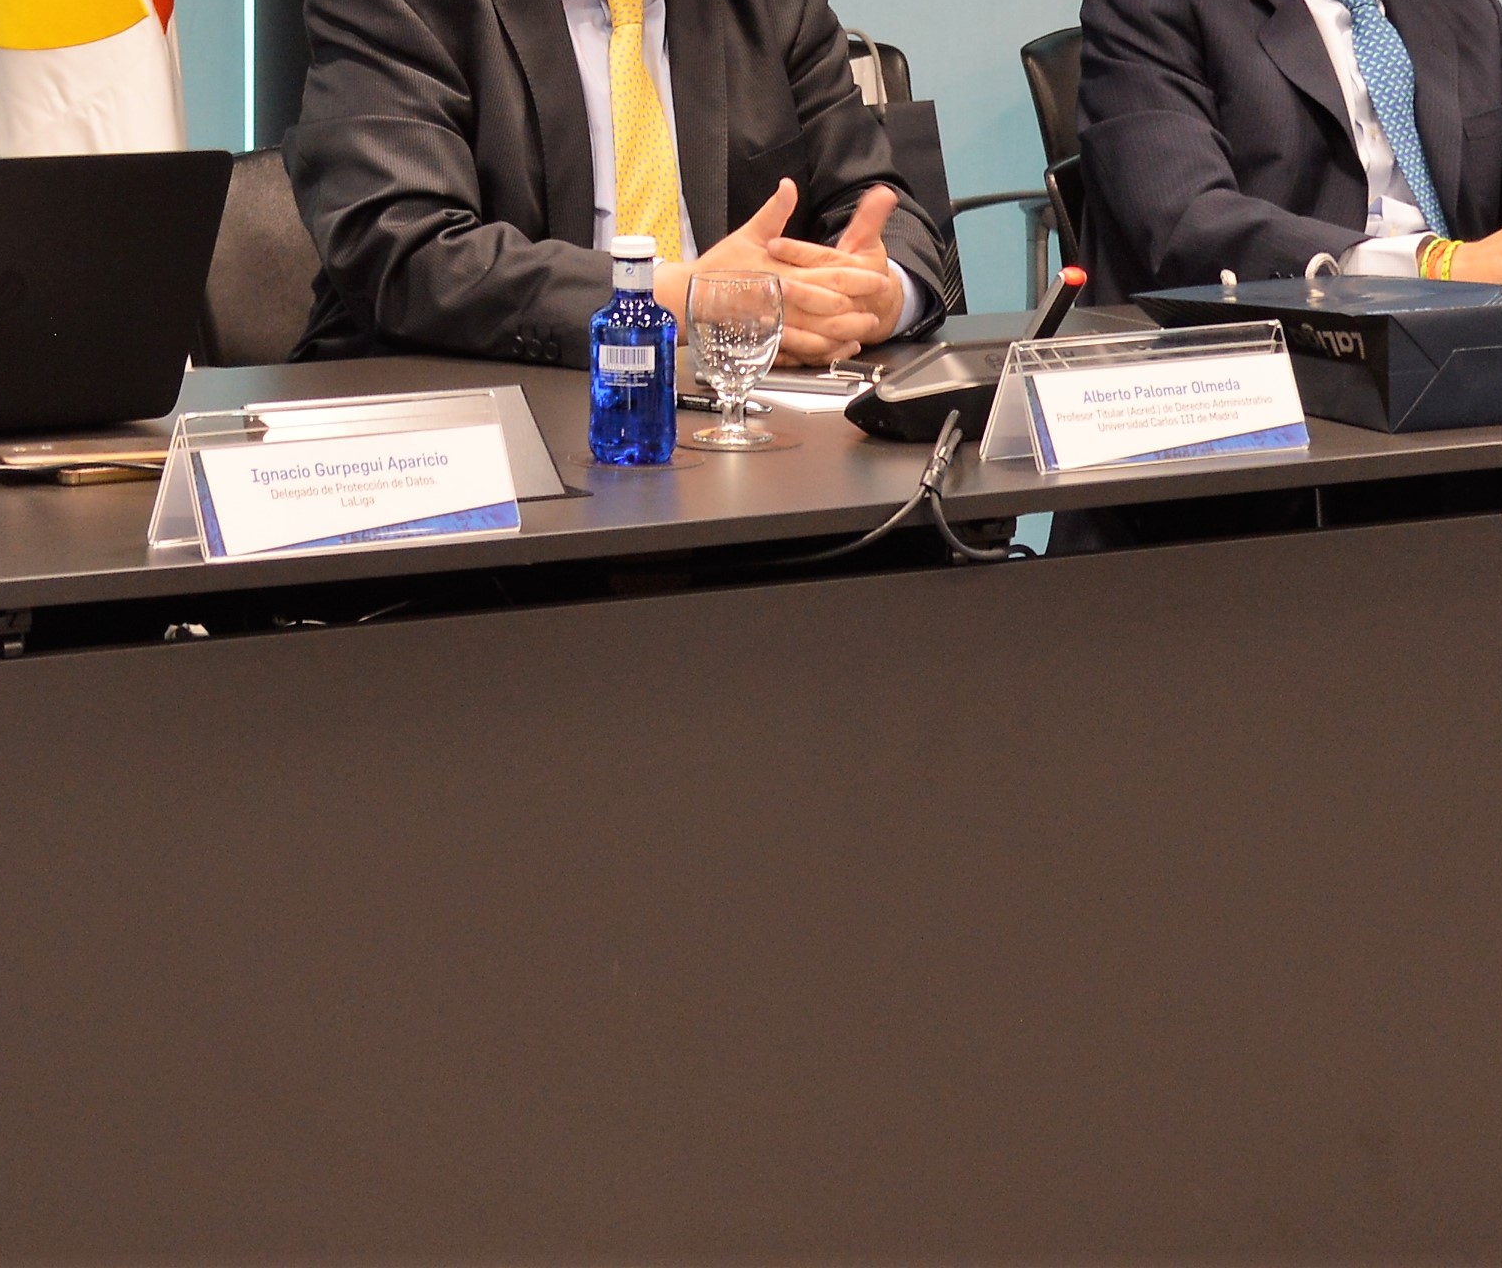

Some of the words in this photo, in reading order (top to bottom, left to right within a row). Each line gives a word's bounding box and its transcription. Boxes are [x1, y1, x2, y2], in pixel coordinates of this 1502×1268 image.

[1083, 388, 1131, 404] Alberto
[1134, 384, 1188, 399] Palomar
[1191, 378, 1241, 394] Olmeda
[1056, 410, 1094, 422] Profesor
[1097, 407, 1125, 419] Titular
[1163, 403, 1173, 413] de
[1175, 400, 1211, 412] Derecho
[1212, 395, 1273, 409] Administrativo
[1097, 418, 1149, 432] Universidad
[1150, 416, 1179, 427] Carlos
[1180, 414, 1195, 425] III
[1197, 413, 1208, 424] de
[1209, 410, 1239, 422] Madrid
[250, 464, 311, 485] Ignacio
[314, 457, 383, 478] Gurpegui
[387, 452, 449, 472] Aparicio
[270, 484, 319, 500] Delegado
[321, 484, 334, 495] de
[335, 479, 389, 494] Protección
[391, 476, 404, 488] de
[341, 496, 375, 508] LaLiga
